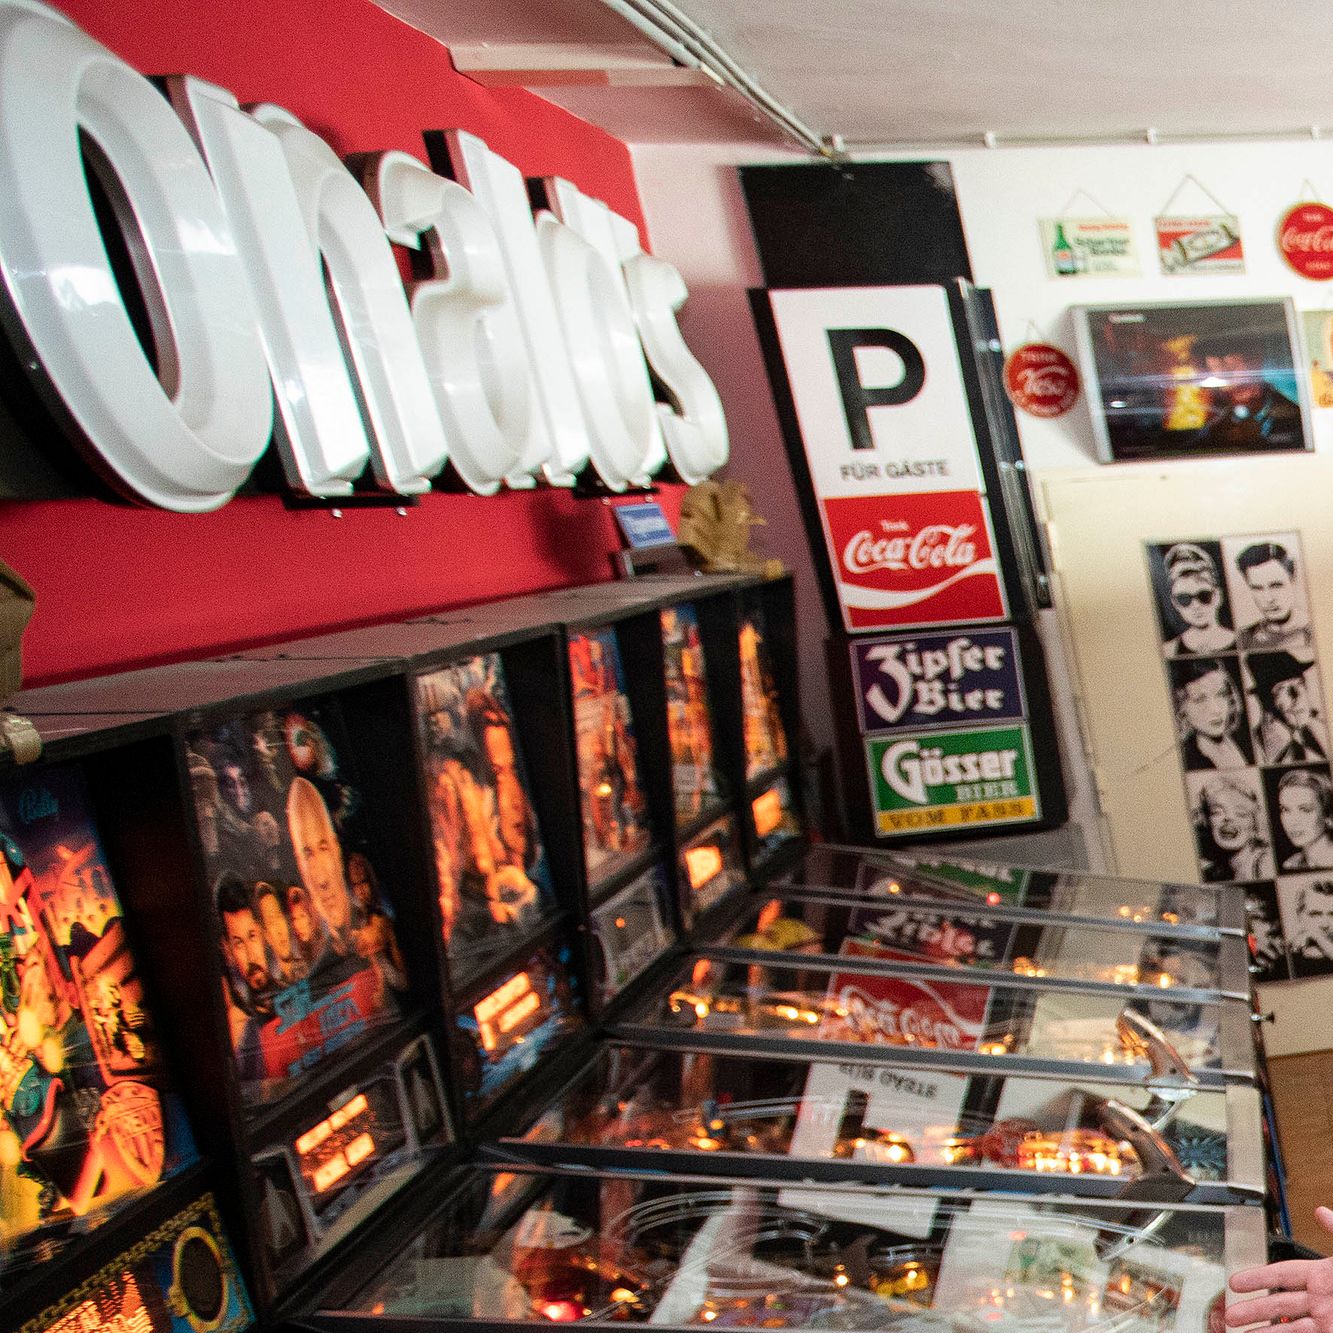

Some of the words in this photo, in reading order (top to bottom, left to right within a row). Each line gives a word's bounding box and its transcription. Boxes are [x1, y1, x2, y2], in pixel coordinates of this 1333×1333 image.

[825, 328, 925, 450] P
[840, 459, 879, 481] FÜR
[885, 457, 949, 480] GÄSTE
[843, 523, 977, 574] Coca-Cola
[864, 637, 1005, 724] Zipfer
[912, 679, 1004, 716] Bier
[882, 741, 1017, 805] Gösser
[955, 780, 1018, 800] BIER
